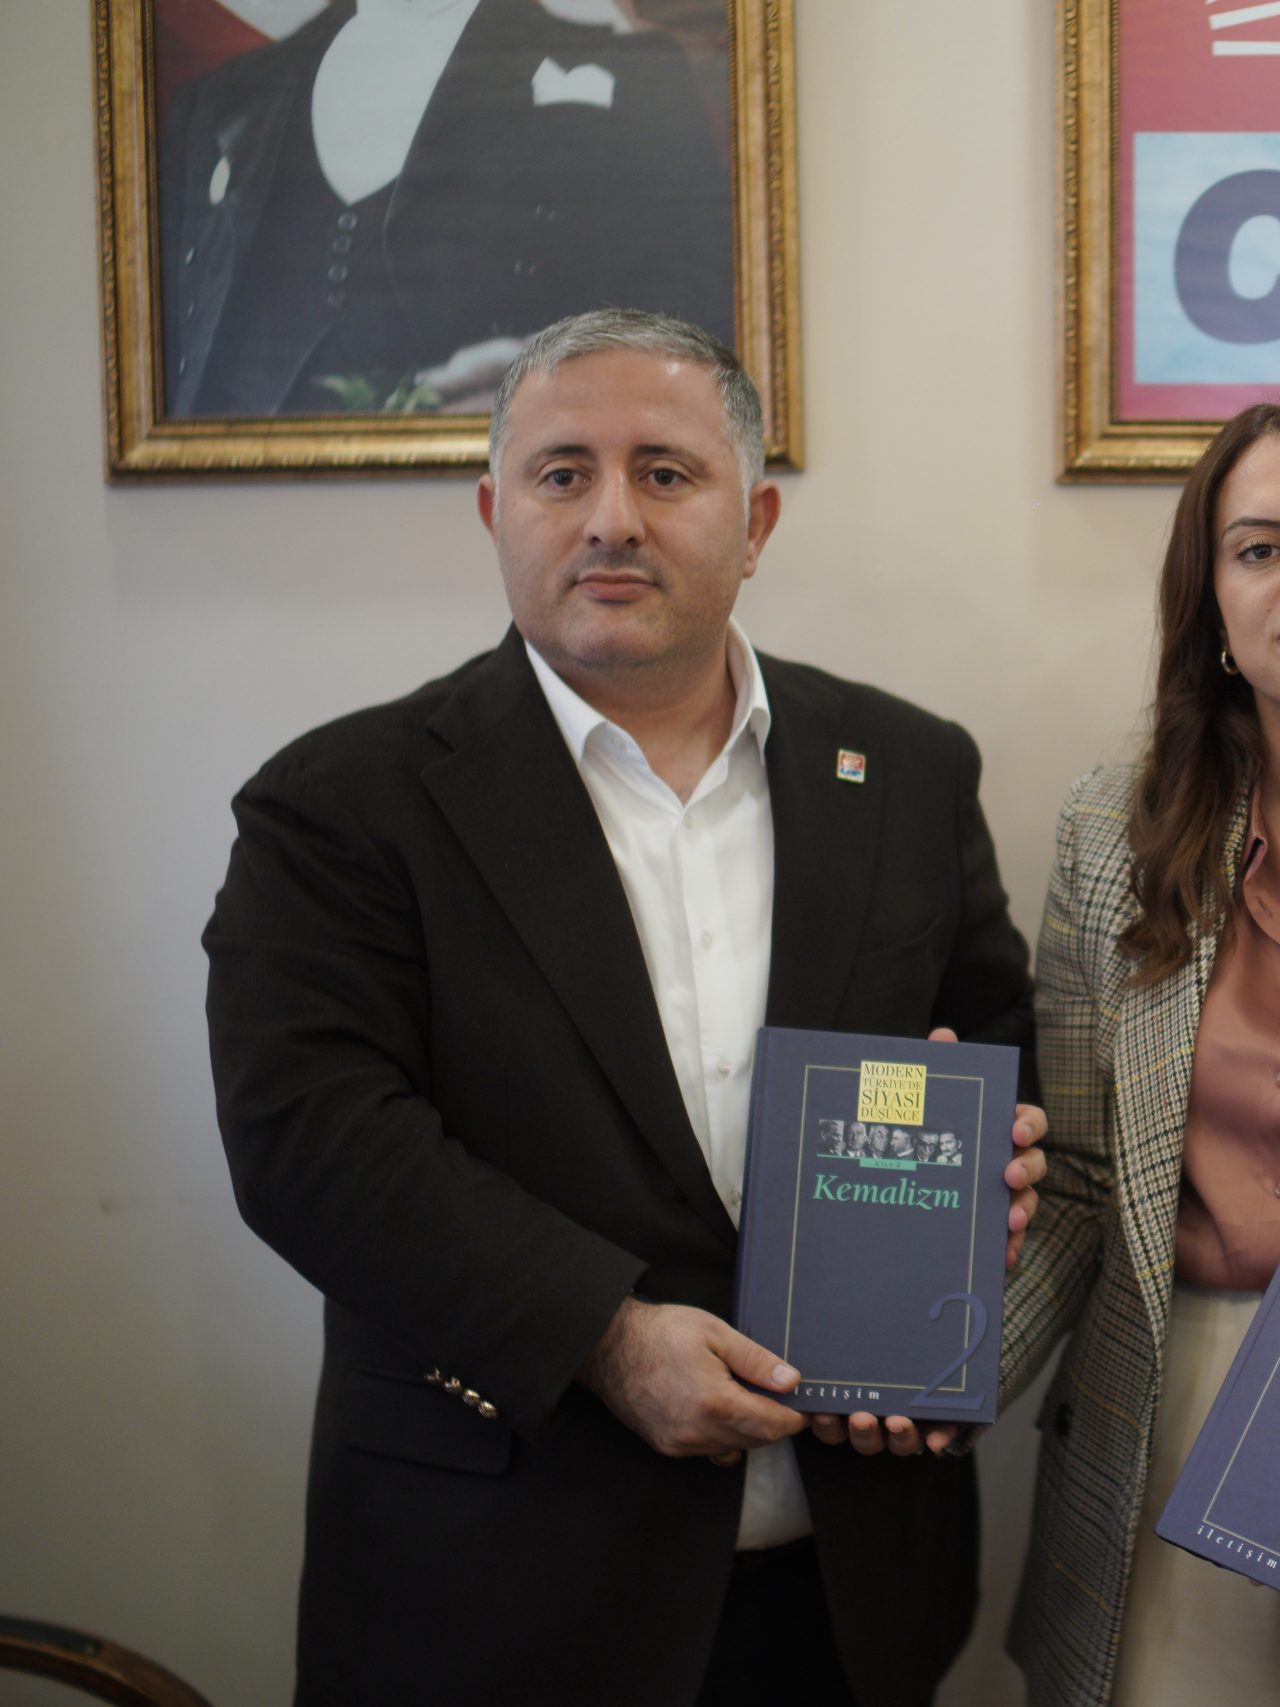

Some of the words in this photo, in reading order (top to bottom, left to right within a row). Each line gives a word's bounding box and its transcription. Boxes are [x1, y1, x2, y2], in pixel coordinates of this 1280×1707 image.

[864, 1063, 924, 1079] MODERN
[861, 1105, 920, 1122] DÜŞÜNCE
[812, 1173, 961, 1211] Kemalizm
[909, 1292, 988, 1411] 2
[794, 1385, 880, 1401] letişim
[1197, 1525, 1278, 1569] iletişim
